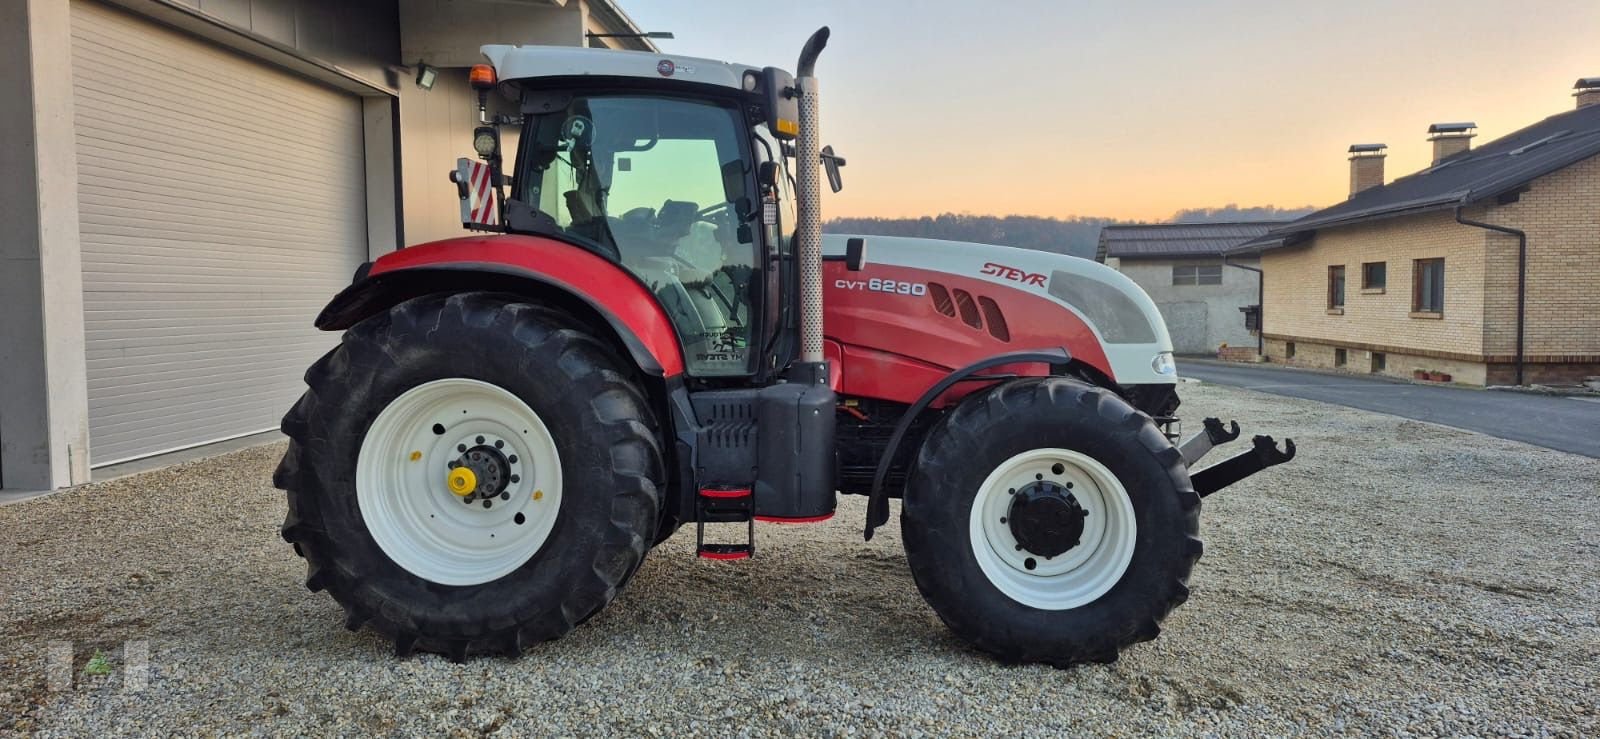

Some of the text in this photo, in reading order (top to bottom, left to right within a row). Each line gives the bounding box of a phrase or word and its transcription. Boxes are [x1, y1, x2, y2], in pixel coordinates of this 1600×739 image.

[980, 262, 1048, 288] STEYR
[835, 278, 927, 296] CVT 6230
